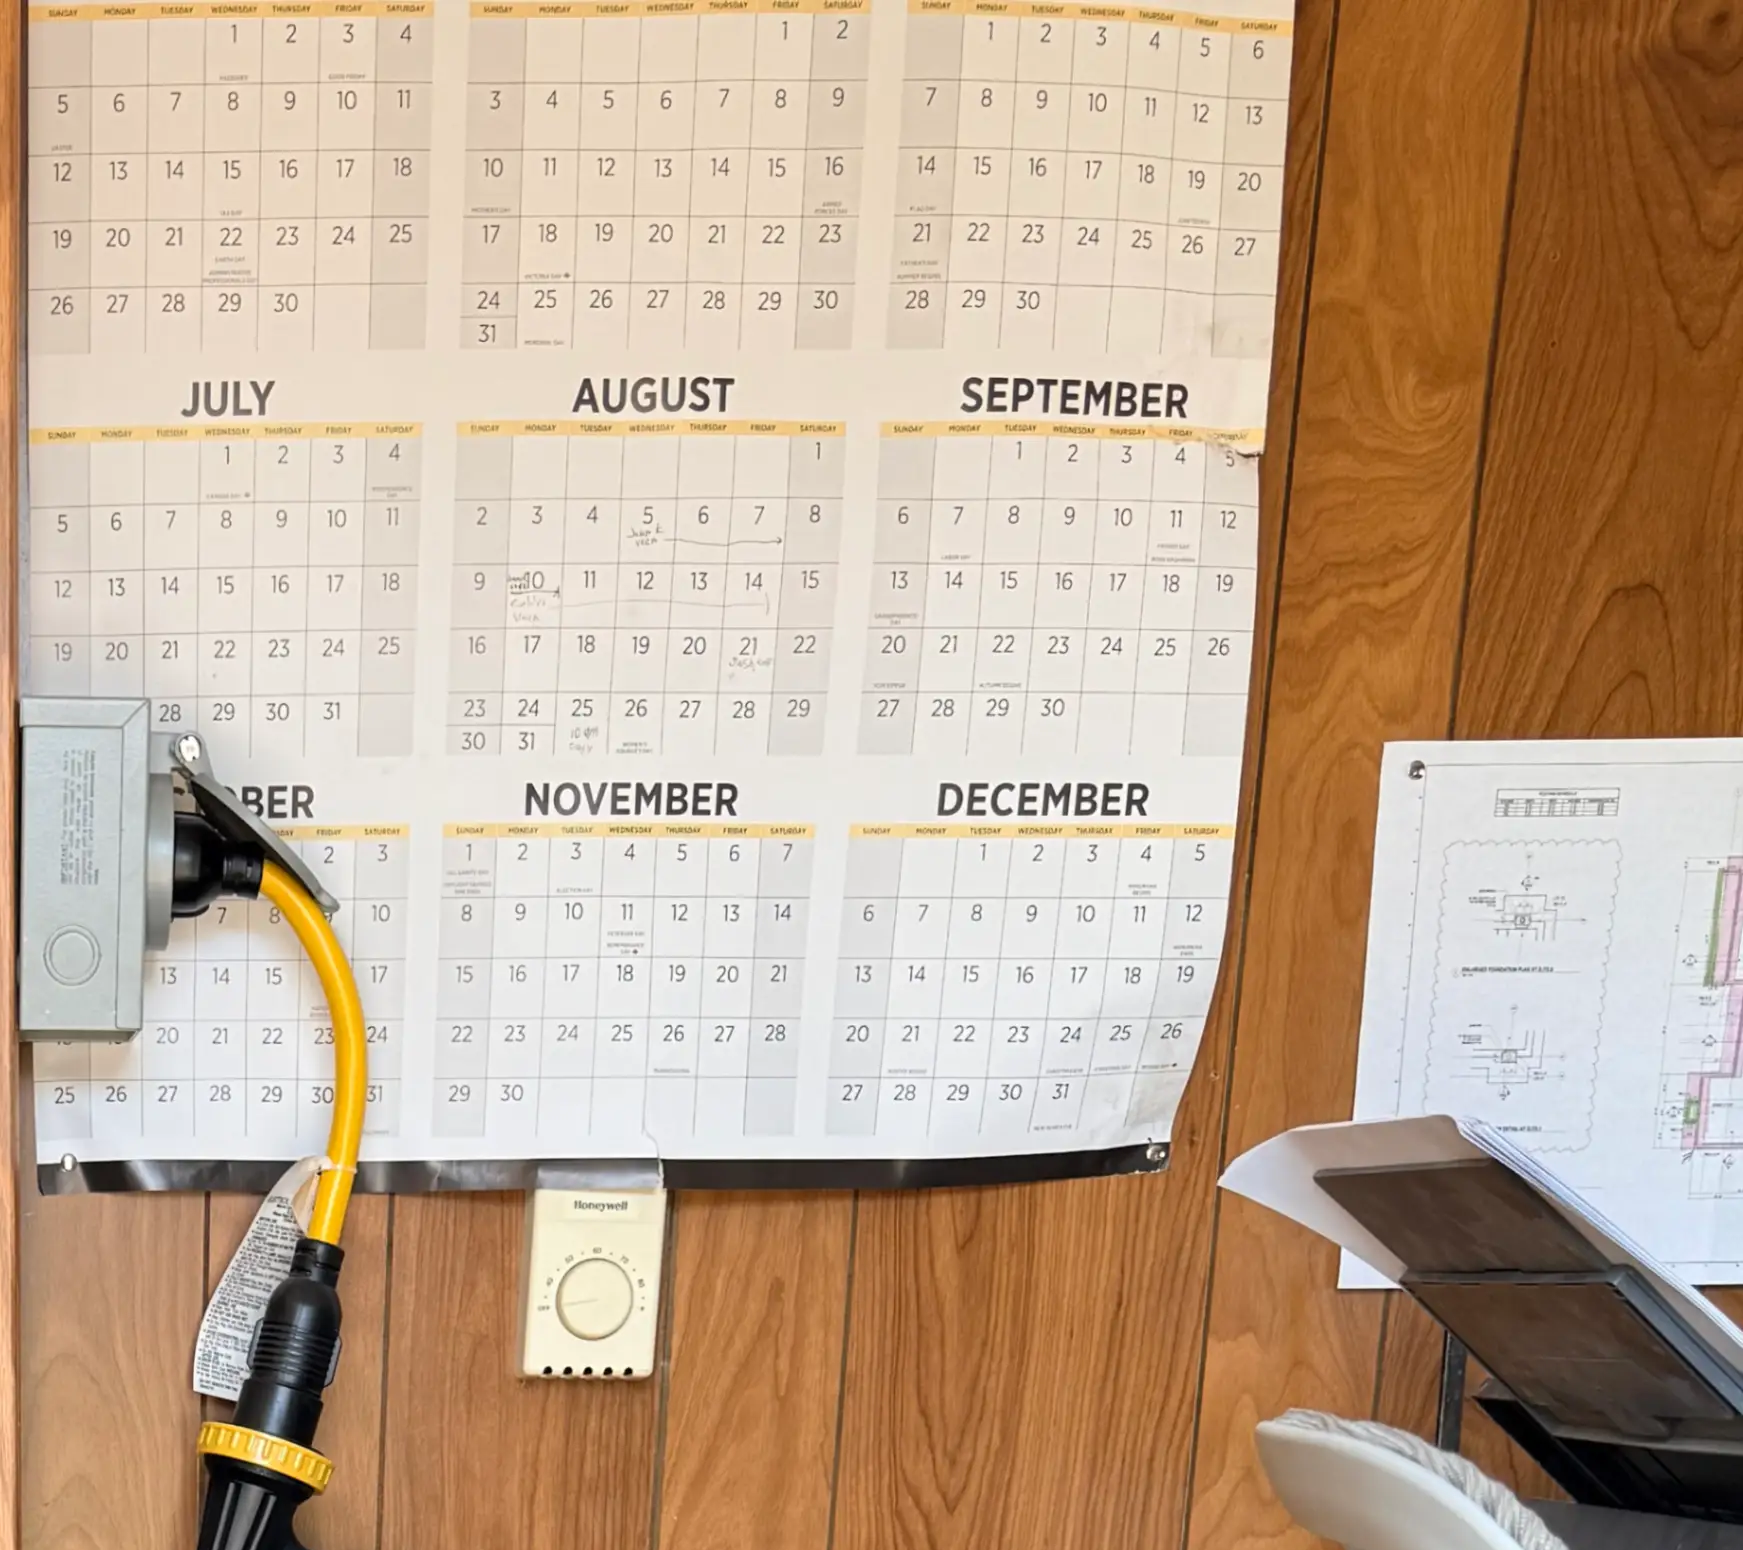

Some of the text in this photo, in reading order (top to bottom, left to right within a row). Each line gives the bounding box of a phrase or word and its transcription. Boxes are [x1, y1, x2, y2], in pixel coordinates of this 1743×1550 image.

[57, 88, 411, 115] 5 6 7 8 9 10 11
[483, 155, 844, 178] 10 11 12 13 14 15 16
[181, 380, 276, 418] JULY
[572, 376, 736, 414] AUGUST
[960, 376, 1189, 419] SEPTEMBER
[48, 425, 414, 440] SUNDAY MONDAY TUESDAY WEDNESDAY THURSDAY FRIDAY SATURDAY
[57, 506, 399, 534] 5 6 7 8 9 10 11
[880, 634, 1230, 657] 20 21 22 23 24 25 26
[524, 781, 739, 818] NOVEMBER
[937, 781, 1150, 818] DECEMBER
[460, 901, 792, 923] 8 9 10 11 12 13 14
[855, 964, 1195, 985] 13 14 15 16 17 18 19
[574, 1200, 628, 1212] Honeywell
